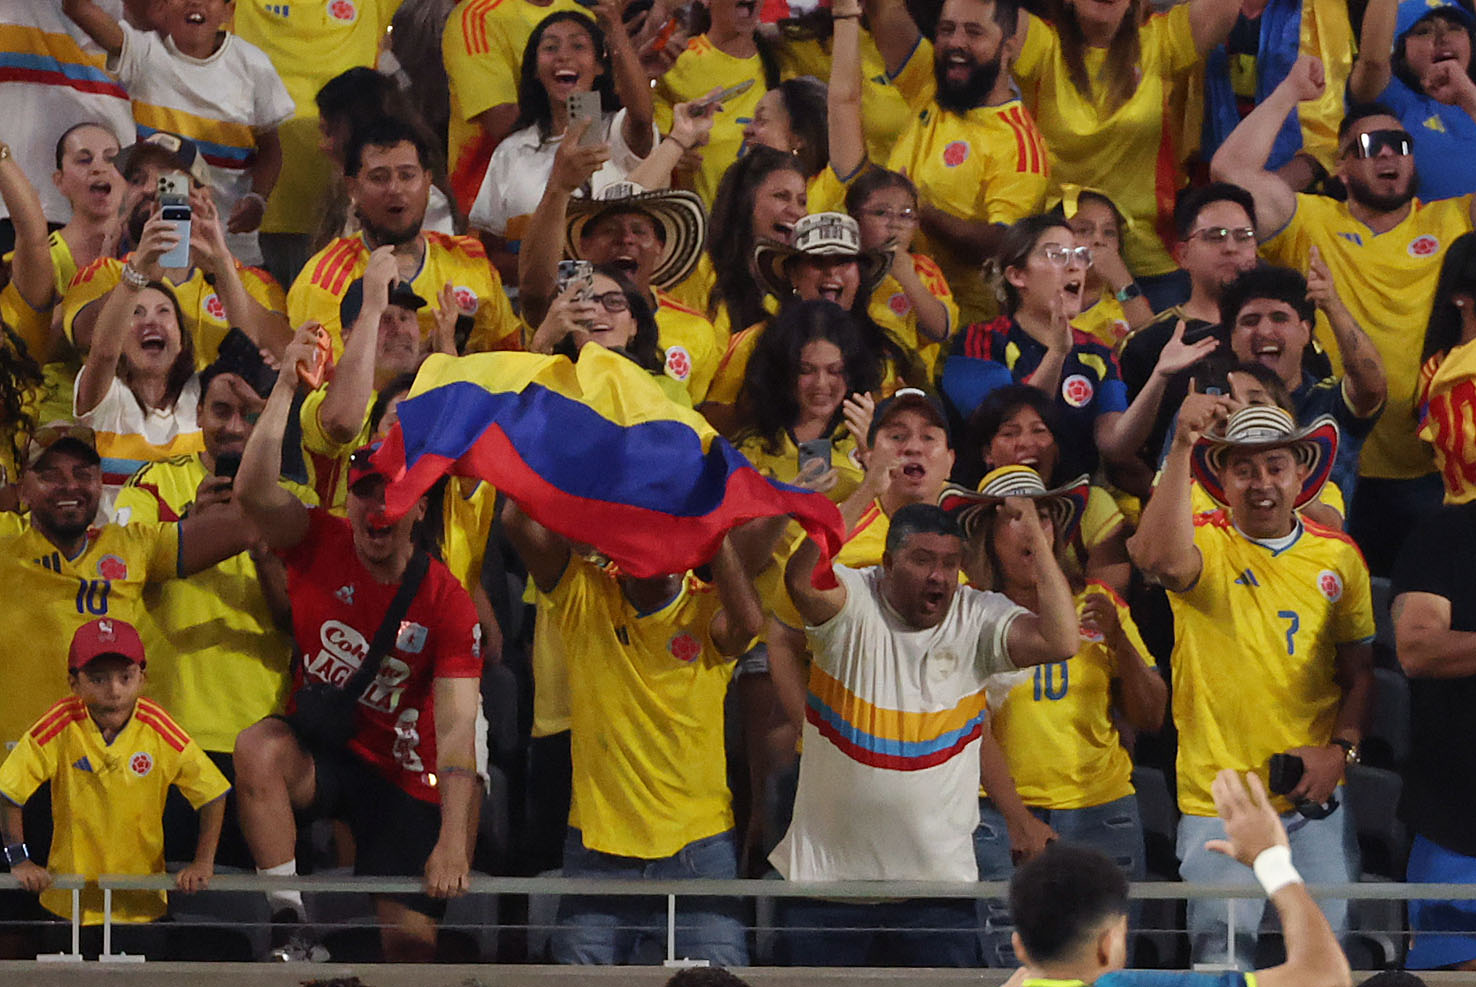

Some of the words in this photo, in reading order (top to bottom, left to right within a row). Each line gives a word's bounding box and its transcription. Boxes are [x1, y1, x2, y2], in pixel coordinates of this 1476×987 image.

[76, 577, 111, 616] 10
[1277, 610, 1299, 656] 7
[1033, 661, 1069, 701] 10
